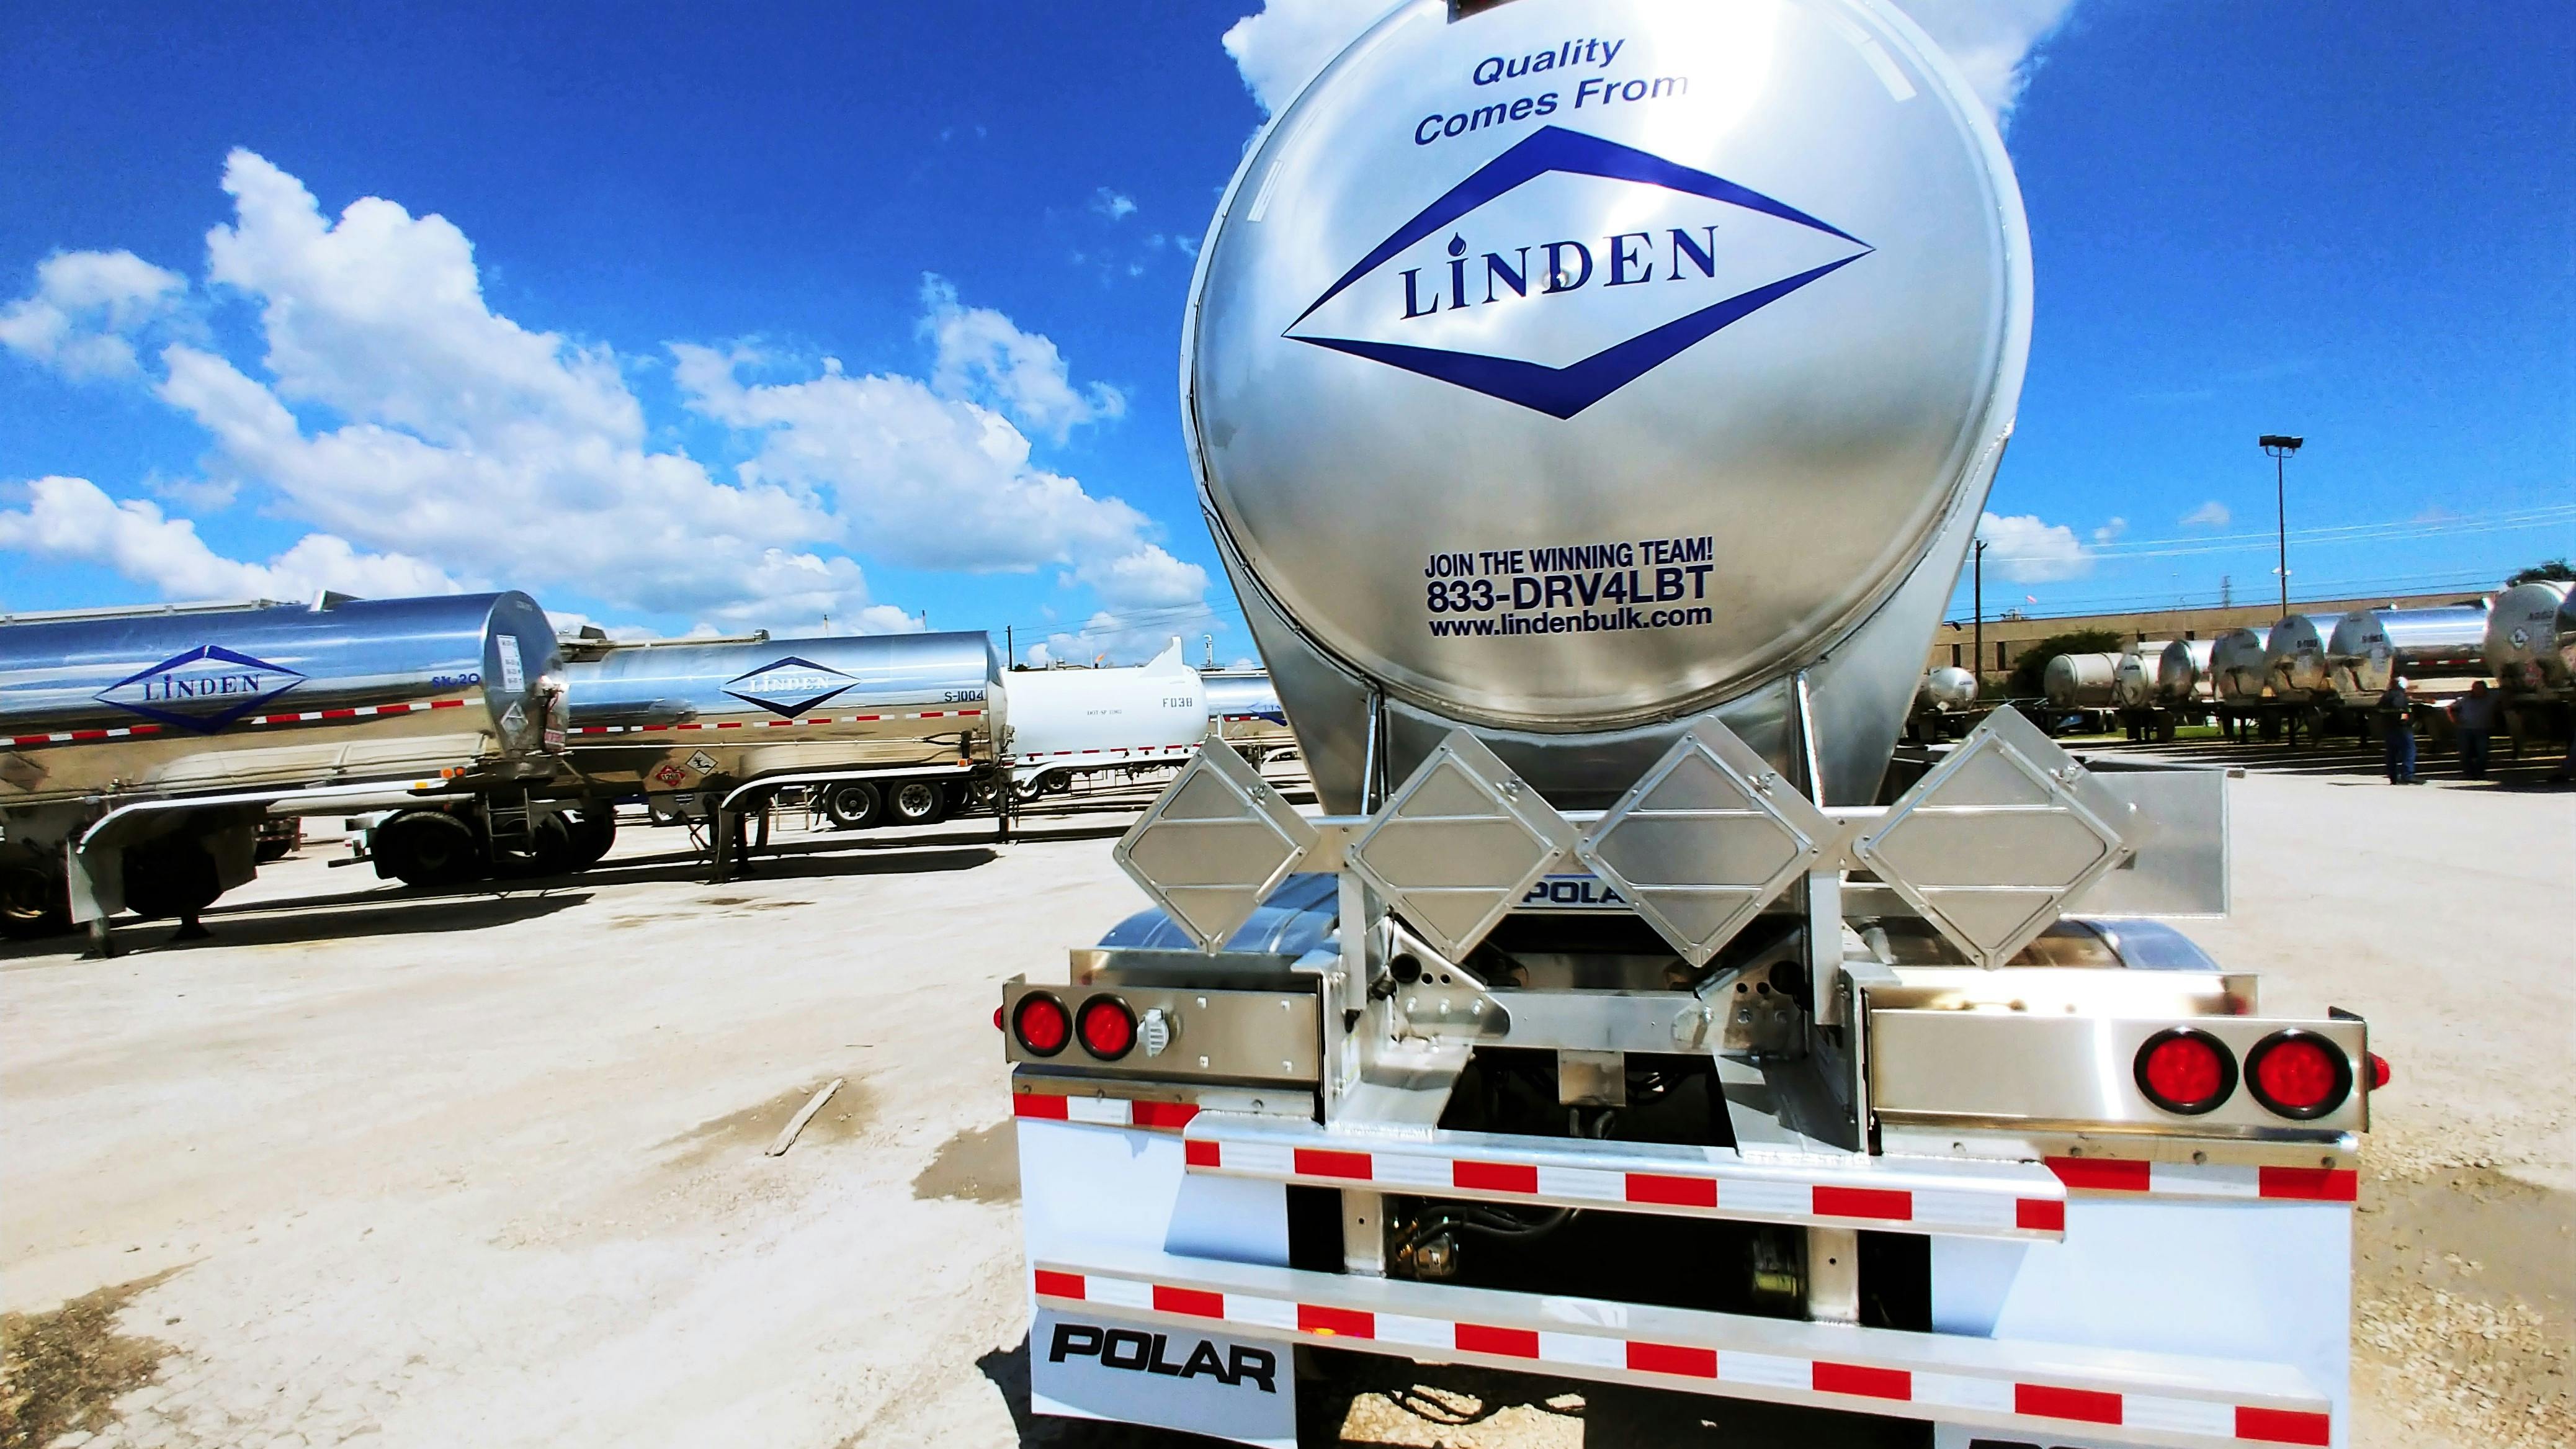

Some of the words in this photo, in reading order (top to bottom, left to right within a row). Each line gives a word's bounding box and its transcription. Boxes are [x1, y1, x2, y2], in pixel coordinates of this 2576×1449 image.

[1474, 37, 1625, 86] Quality
[1415, 92, 1559, 146] Comes
[1574, 76, 1688, 109] From
[1424, 553, 1474, 578] JOIN
[1479, 550, 1524, 575] THE
[1529, 542, 1633, 572] WINNING
[1639, 536, 1713, 565] TEAM!
[1427, 564, 1714, 613] 833-DRV4LBT
[1429, 606, 1712, 637] www.lindenbulk.com
[944, 689, 984, 702] S-1004
[1522, 881, 1627, 904] POLA
[1049, 1322, 1277, 1393] POLAR
